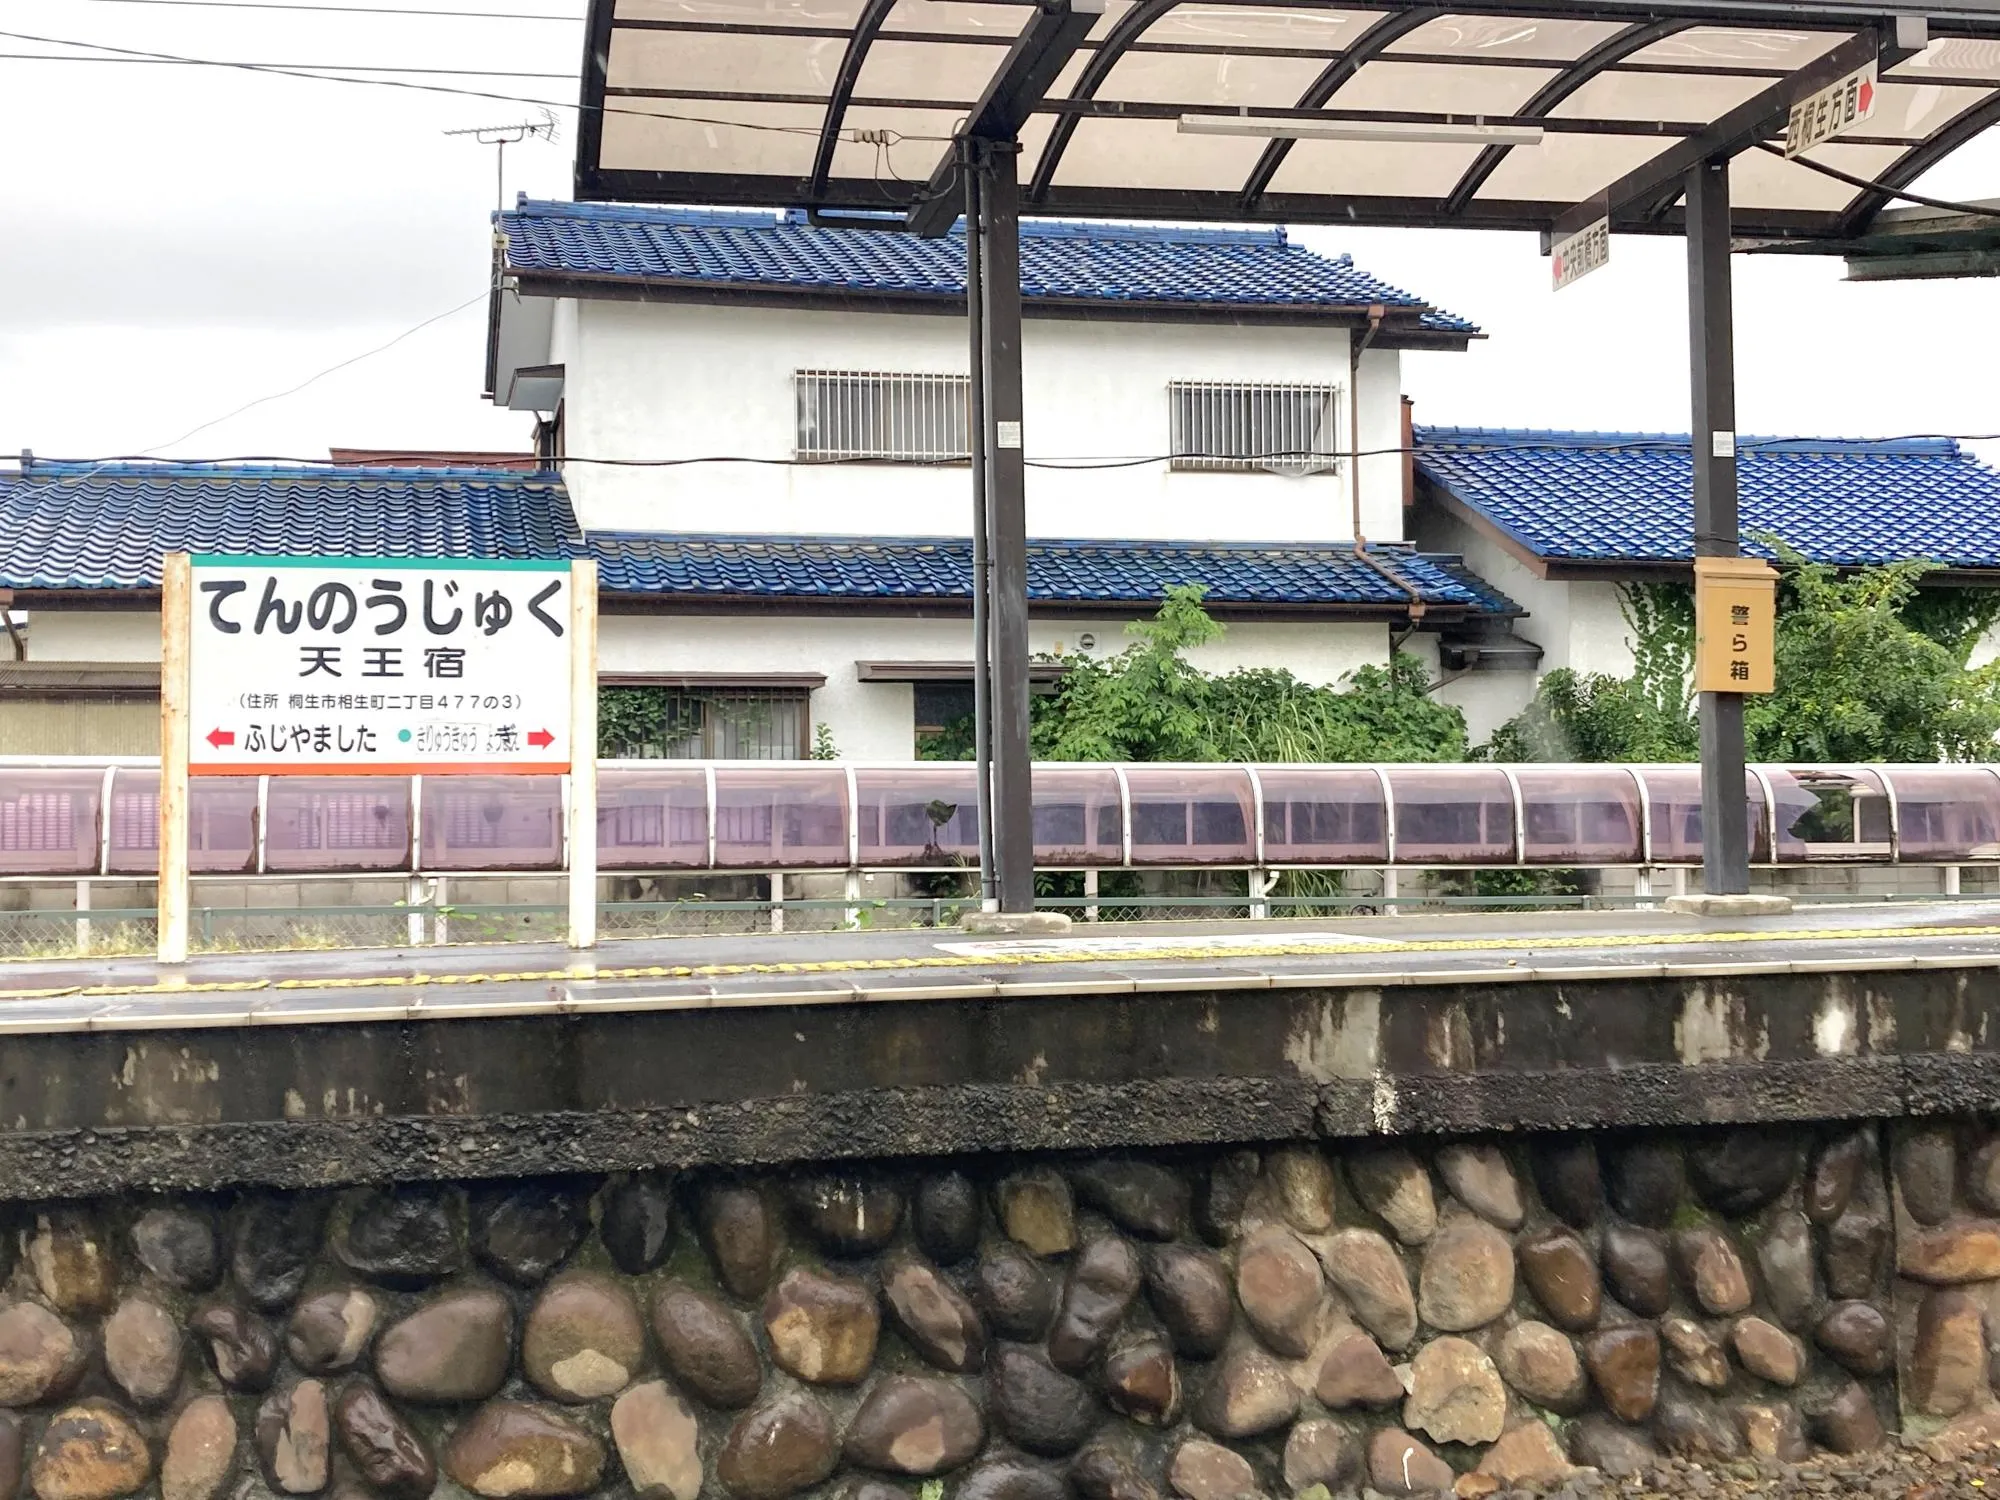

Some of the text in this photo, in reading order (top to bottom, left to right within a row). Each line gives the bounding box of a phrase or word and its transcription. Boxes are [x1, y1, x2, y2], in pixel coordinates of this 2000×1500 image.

[1786, 77, 1858, 153] 西桐生方面
[200, 576, 565, 638] てんのうじゅく
[299, 646, 466, 679] 天王宿
[1730, 605, 1750, 681] 警ら箱
[244, 723, 377, 754] ふじやました
